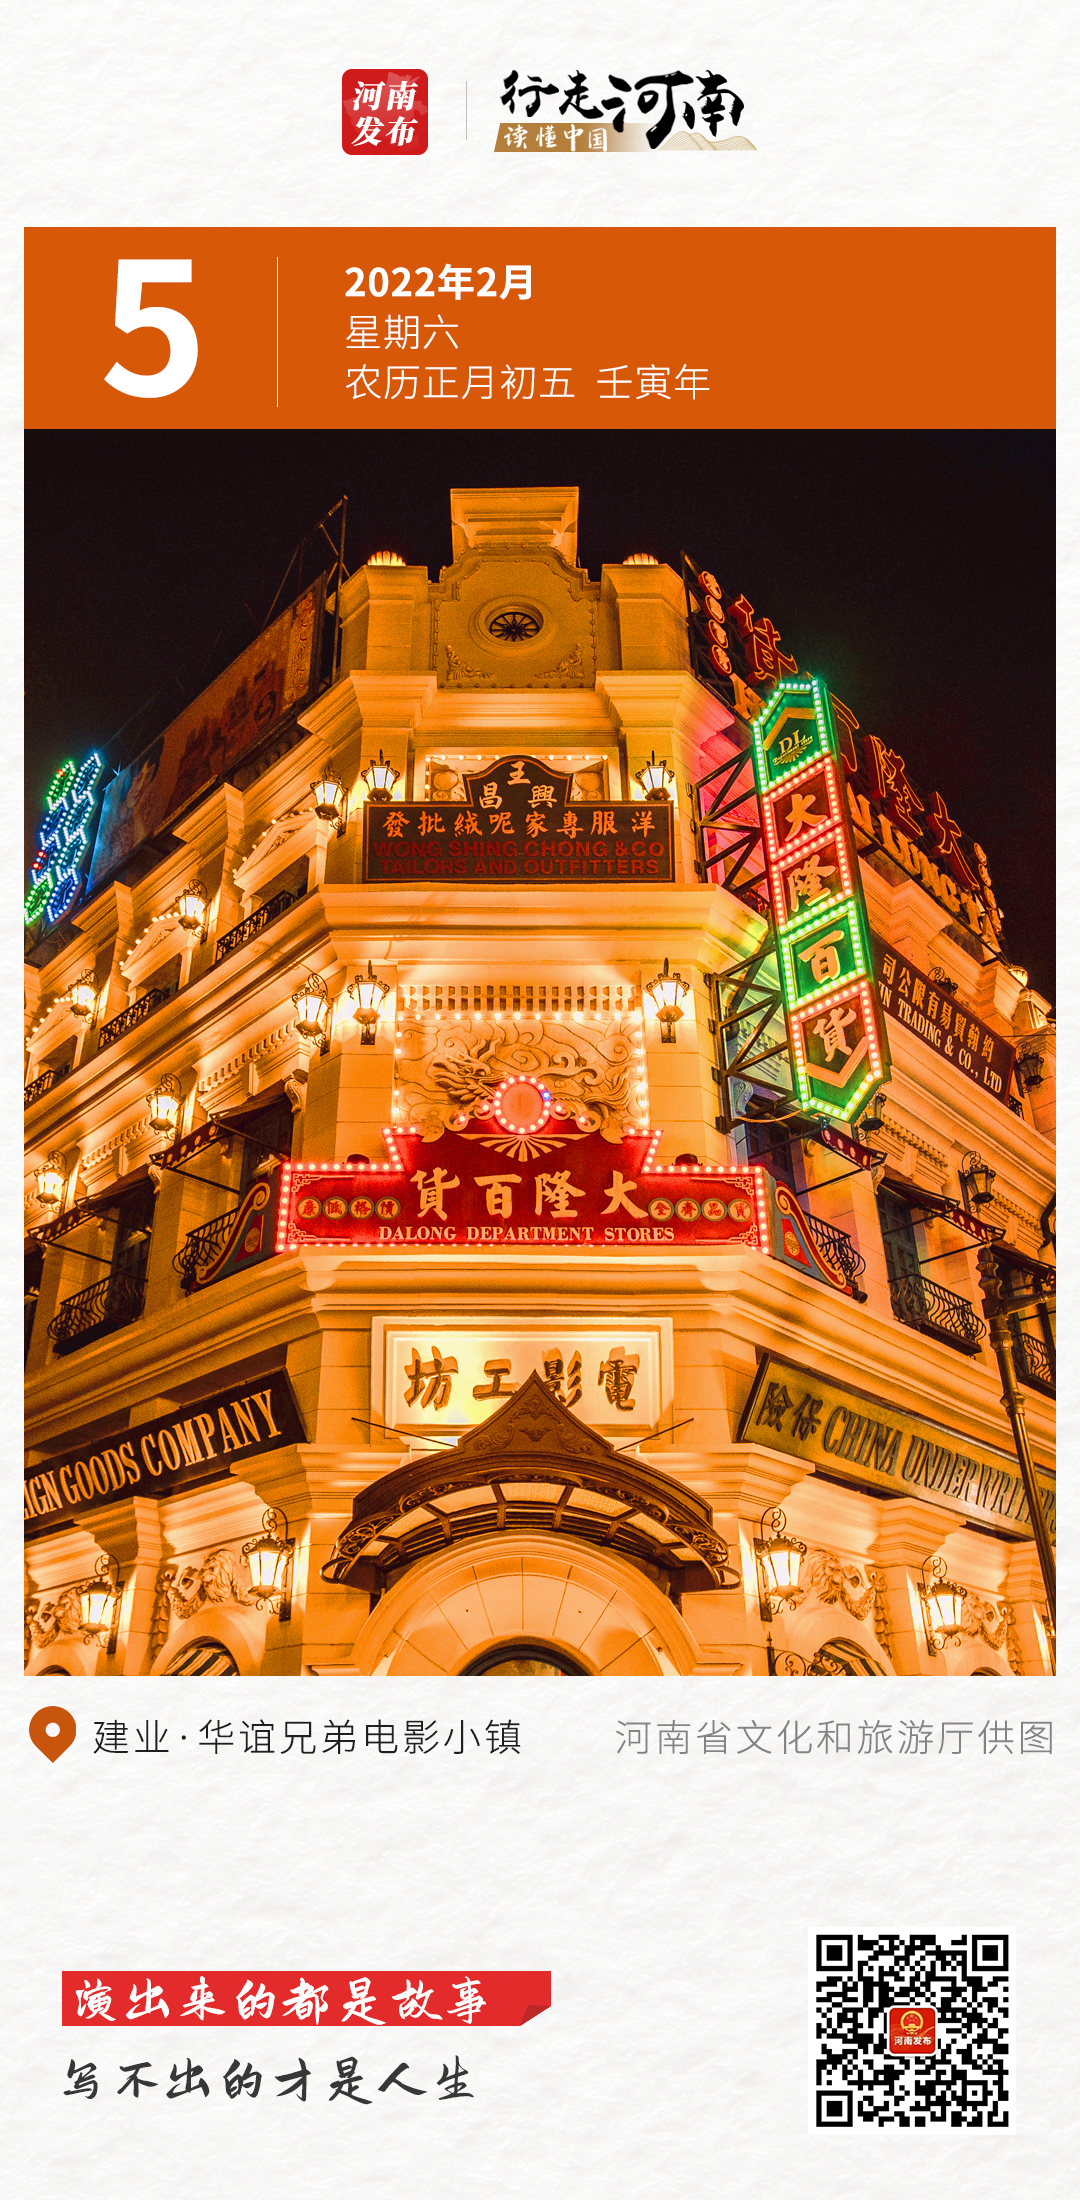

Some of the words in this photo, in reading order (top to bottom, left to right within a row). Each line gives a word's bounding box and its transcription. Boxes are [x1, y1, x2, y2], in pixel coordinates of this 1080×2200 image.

[373, 841, 442, 857] WONG
[448, 840, 518, 857] SHING
[523, 840, 608, 857] CHONG
[380, 859, 467, 875] TAILORS
[474, 860, 517, 875] AND
[523, 859, 659, 875] OUTFITTERS
[784, 792, 857, 1063] 大隆百貨
[898, 998, 942, 1048] TRADING
[944, 1034, 954, 1057] &
[983, 1066, 1003, 1094] LTD
[379, 1226, 457, 1240] DALONG
[467, 1226, 593, 1241] DEPARTMENT
[604, 1227, 675, 1241] STORES
[24, 1471, 63, 1520] IGN
[59, 1441, 141, 1505] GOODS
[140, 1389, 281, 1476] COMPANY
[822, 1406, 903, 1476] CHINA
